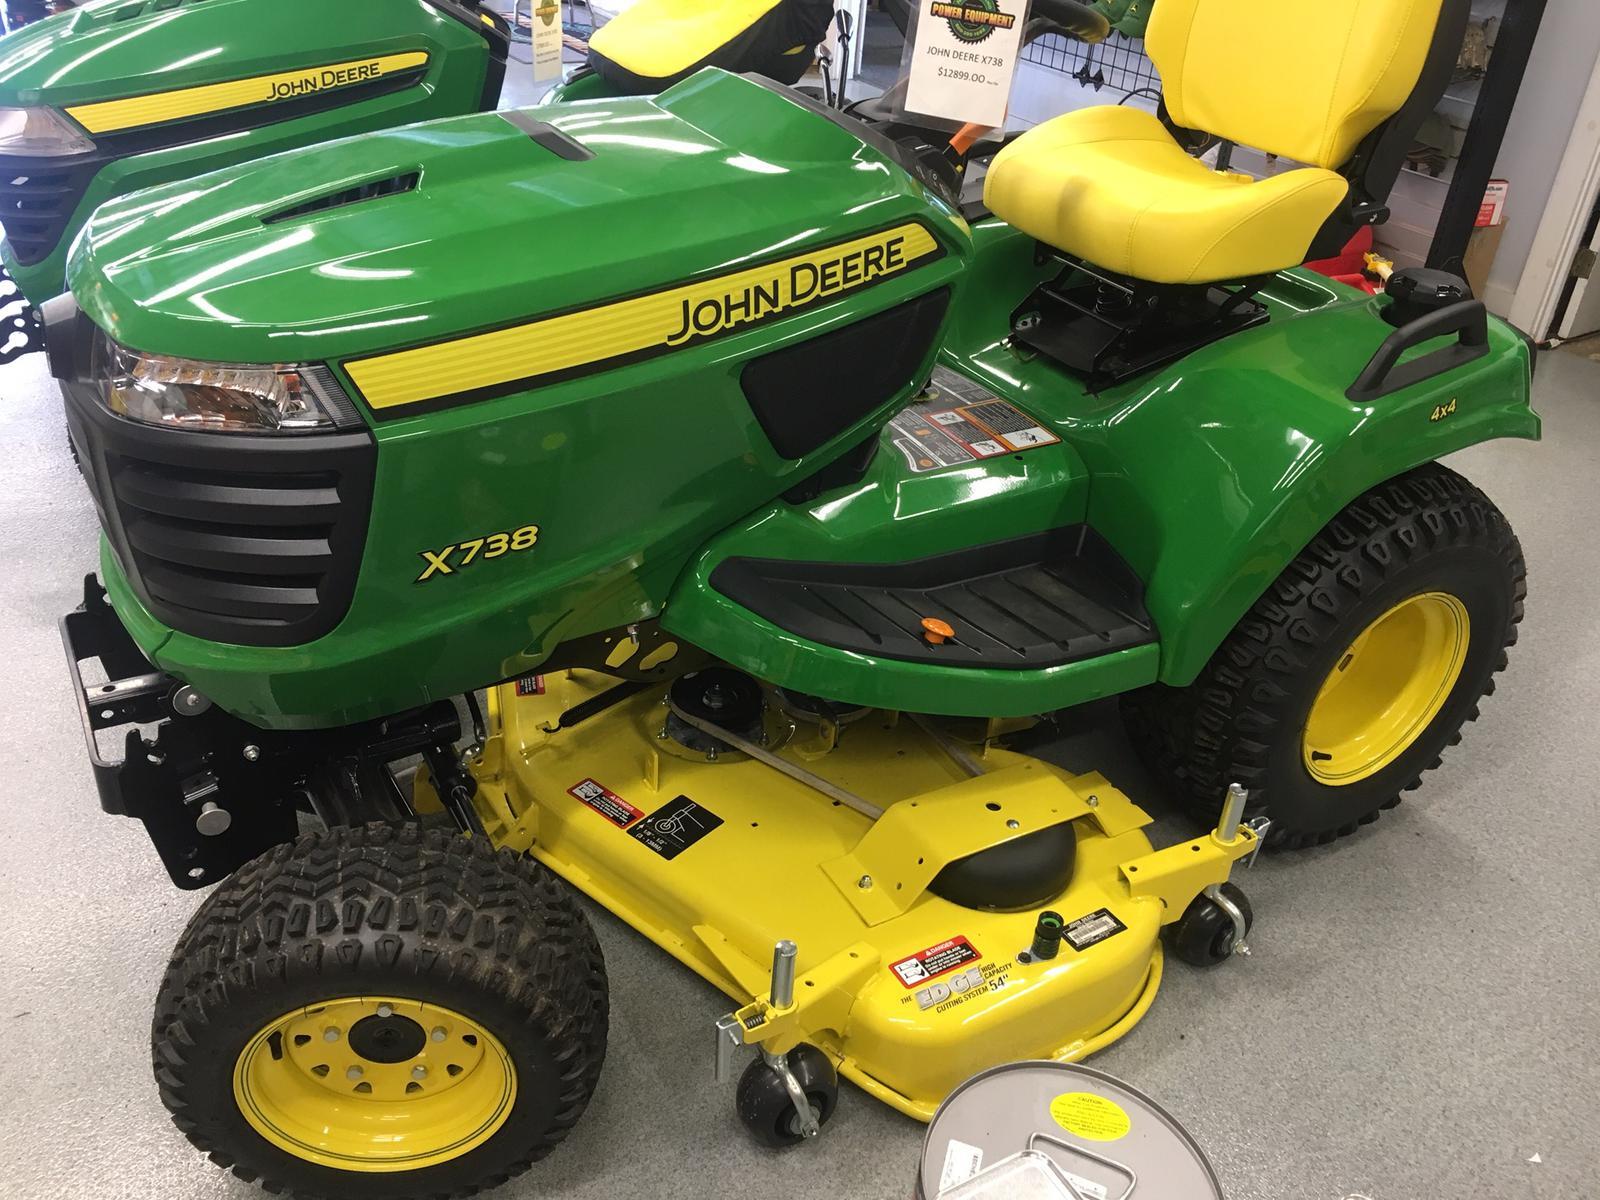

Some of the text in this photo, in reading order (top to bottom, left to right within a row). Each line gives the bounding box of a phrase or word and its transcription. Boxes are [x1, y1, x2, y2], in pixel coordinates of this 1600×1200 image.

[932, 4, 962, 19] POWER
[965, 8, 1014, 28] EQUIPMENT
[927, 46, 1003, 67] JOHN DEERE X738
[266, 62, 381, 100] JOHN DEERE
[667, 236, 904, 343] JOHN DEERE
[1431, 398, 1457, 421] 4x4
[416, 525, 539, 581] X738
[930, 941, 954, 954] DANGER
[981, 963, 996, 973] HIGH
[984, 962, 1013, 979] CAPACITY
[900, 966, 985, 1011] THE EDGE
[936, 996, 964, 1014] CUTTING
[963, 986, 989, 1001] SYSTEM
